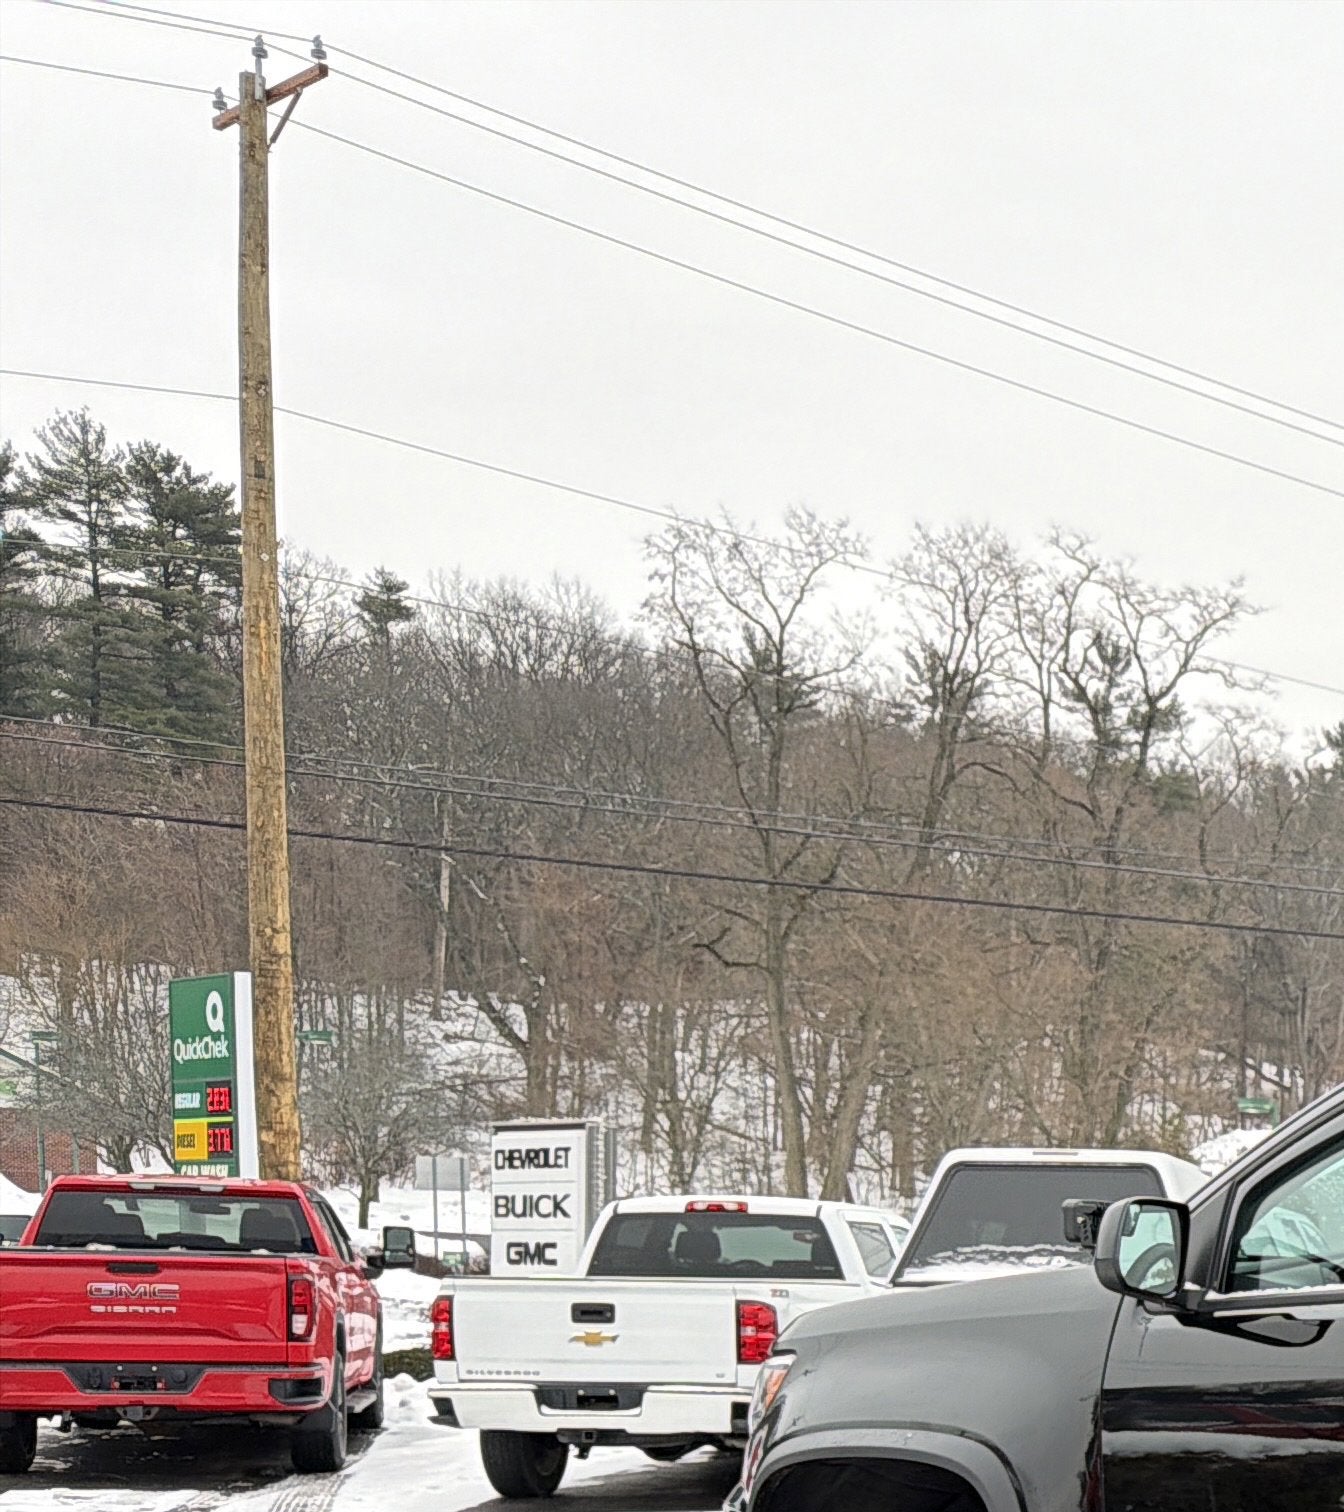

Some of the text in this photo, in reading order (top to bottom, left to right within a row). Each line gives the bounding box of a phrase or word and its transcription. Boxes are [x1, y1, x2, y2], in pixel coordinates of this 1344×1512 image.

[174, 1034, 229, 1064] QuickChek
[176, 1133, 196, 1149] DIESEL
[494, 1146, 572, 1171] CHEVROLET
[494, 1193, 572, 1219] BUICK
[506, 1241, 558, 1267] GMC
[86, 1282, 180, 1300] GMC
[90, 1305, 177, 1314] SIERRA
